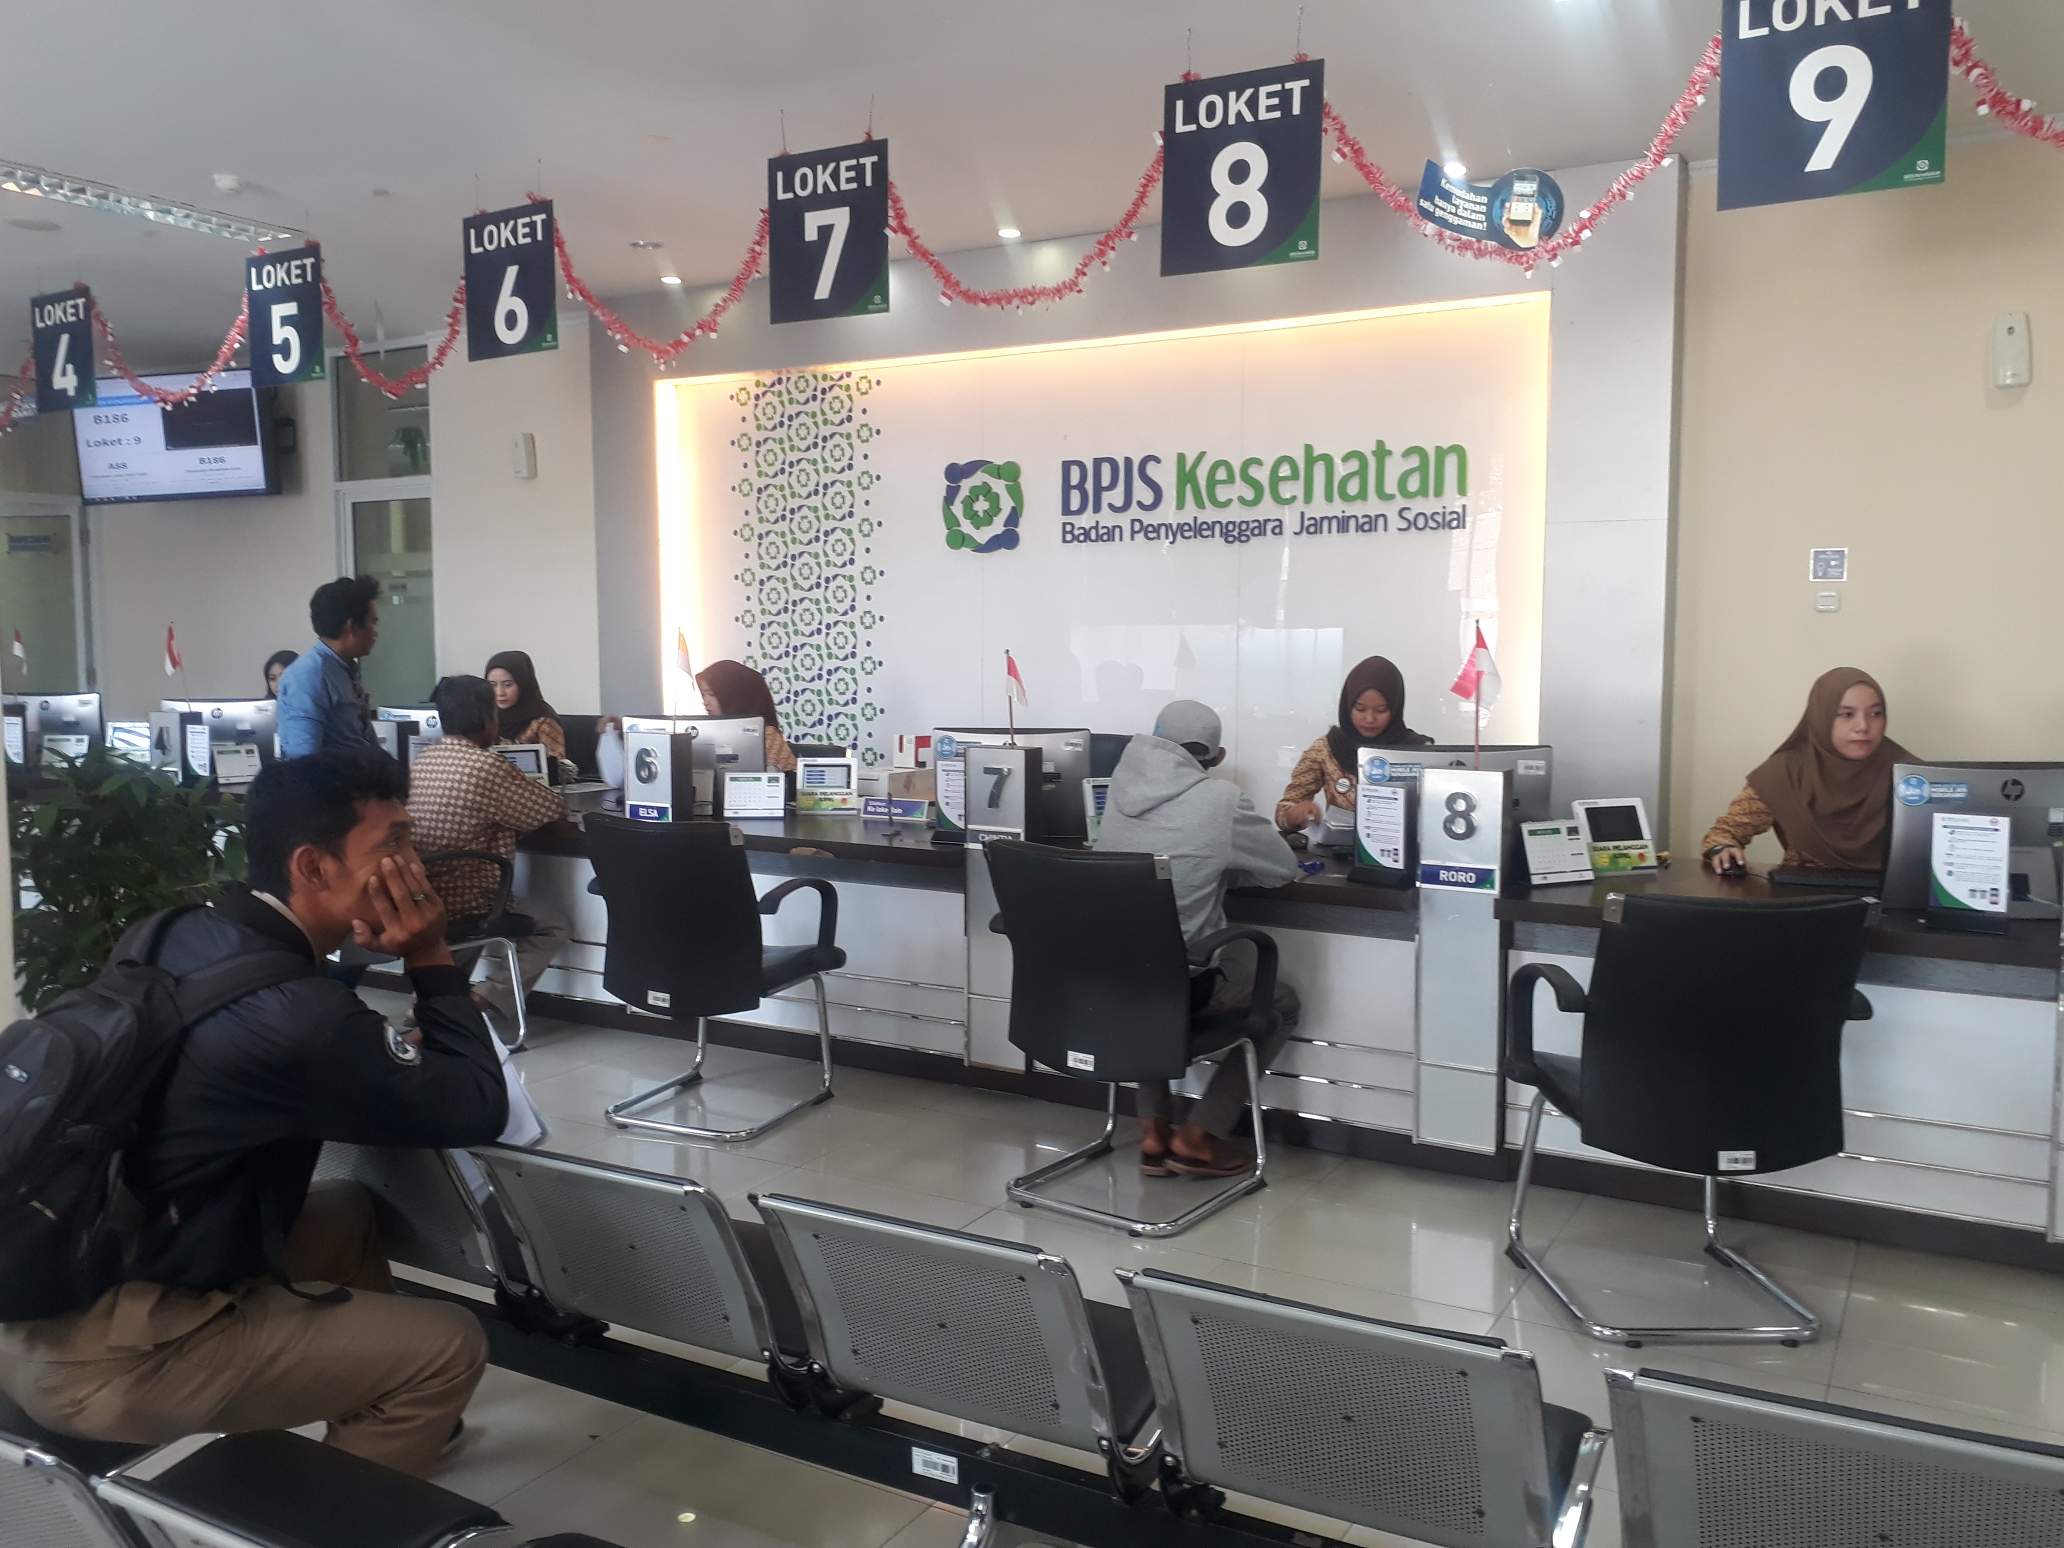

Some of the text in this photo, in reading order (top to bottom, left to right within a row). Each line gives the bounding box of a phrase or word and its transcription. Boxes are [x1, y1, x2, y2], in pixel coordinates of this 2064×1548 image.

[1175, 79, 1311, 134] LOKET
[1789, 44, 1873, 172] 9
[776, 155, 879, 201] LOKET
[1208, 141, 1269, 247] 8
[469, 213, 547, 254] LOKET
[804, 206, 851, 300] 7
[250, 257, 316, 291] LOKET
[34, 297, 87, 328] LOKET
[494, 264, 529, 345] 6
[271, 301, 301, 374] 5
[52, 333, 78, 397] 4
[1061, 439, 1468, 516] BPJS Kesehatan
[1061, 503, 1467, 545] Badan Penyelenggara Jaminan Sosial
[635, 747, 659, 784] 6
[982, 765, 1013, 809] 7
[638, 807, 659, 818] ELSA
[1443, 791, 1479, 841] 8
[1438, 870, 1477, 884] RORO
